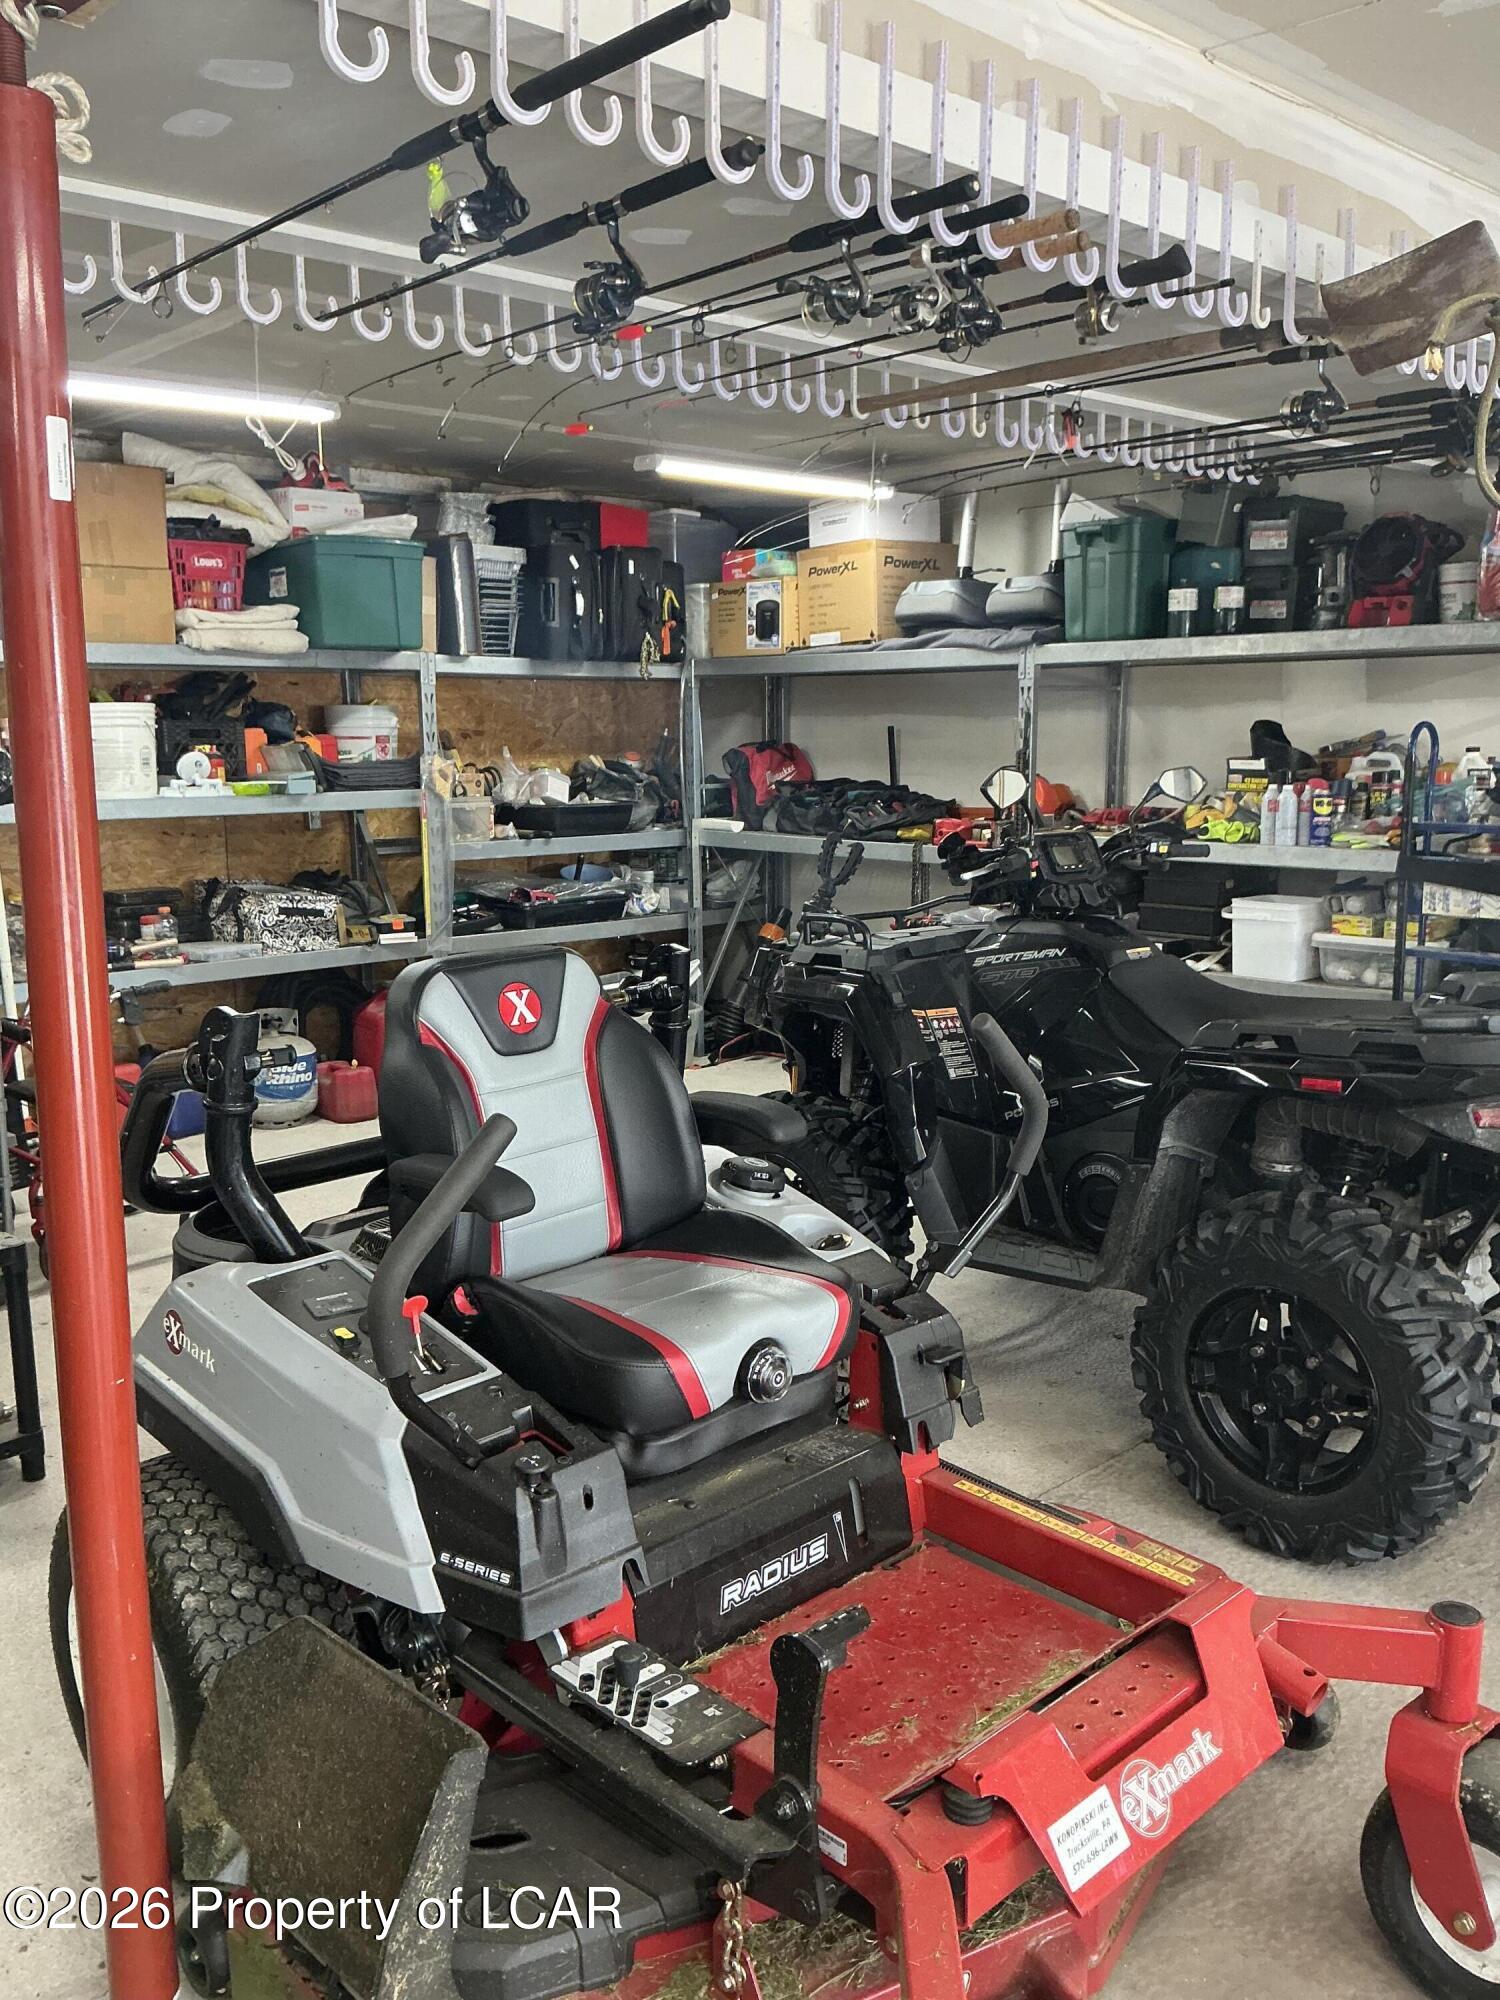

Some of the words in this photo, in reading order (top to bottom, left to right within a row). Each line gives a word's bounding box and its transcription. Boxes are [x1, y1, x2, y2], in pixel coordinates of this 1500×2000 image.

[808, 559, 858, 578] PowerXL
[883, 555, 941, 573] PowerXL
[717, 585, 747, 597] PowerX
[972, 947, 1067, 967] SPORTSMAN
[502, 988, 538, 1027] X
[265, 1071, 313, 1085] Rhino
[163, 1313, 217, 1374] eXmark
[720, 1532, 829, 1615] RADIUS
[1121, 1727, 1224, 1832] eXmark
[1055, 1808, 1097, 1847] KONOPINSKI
